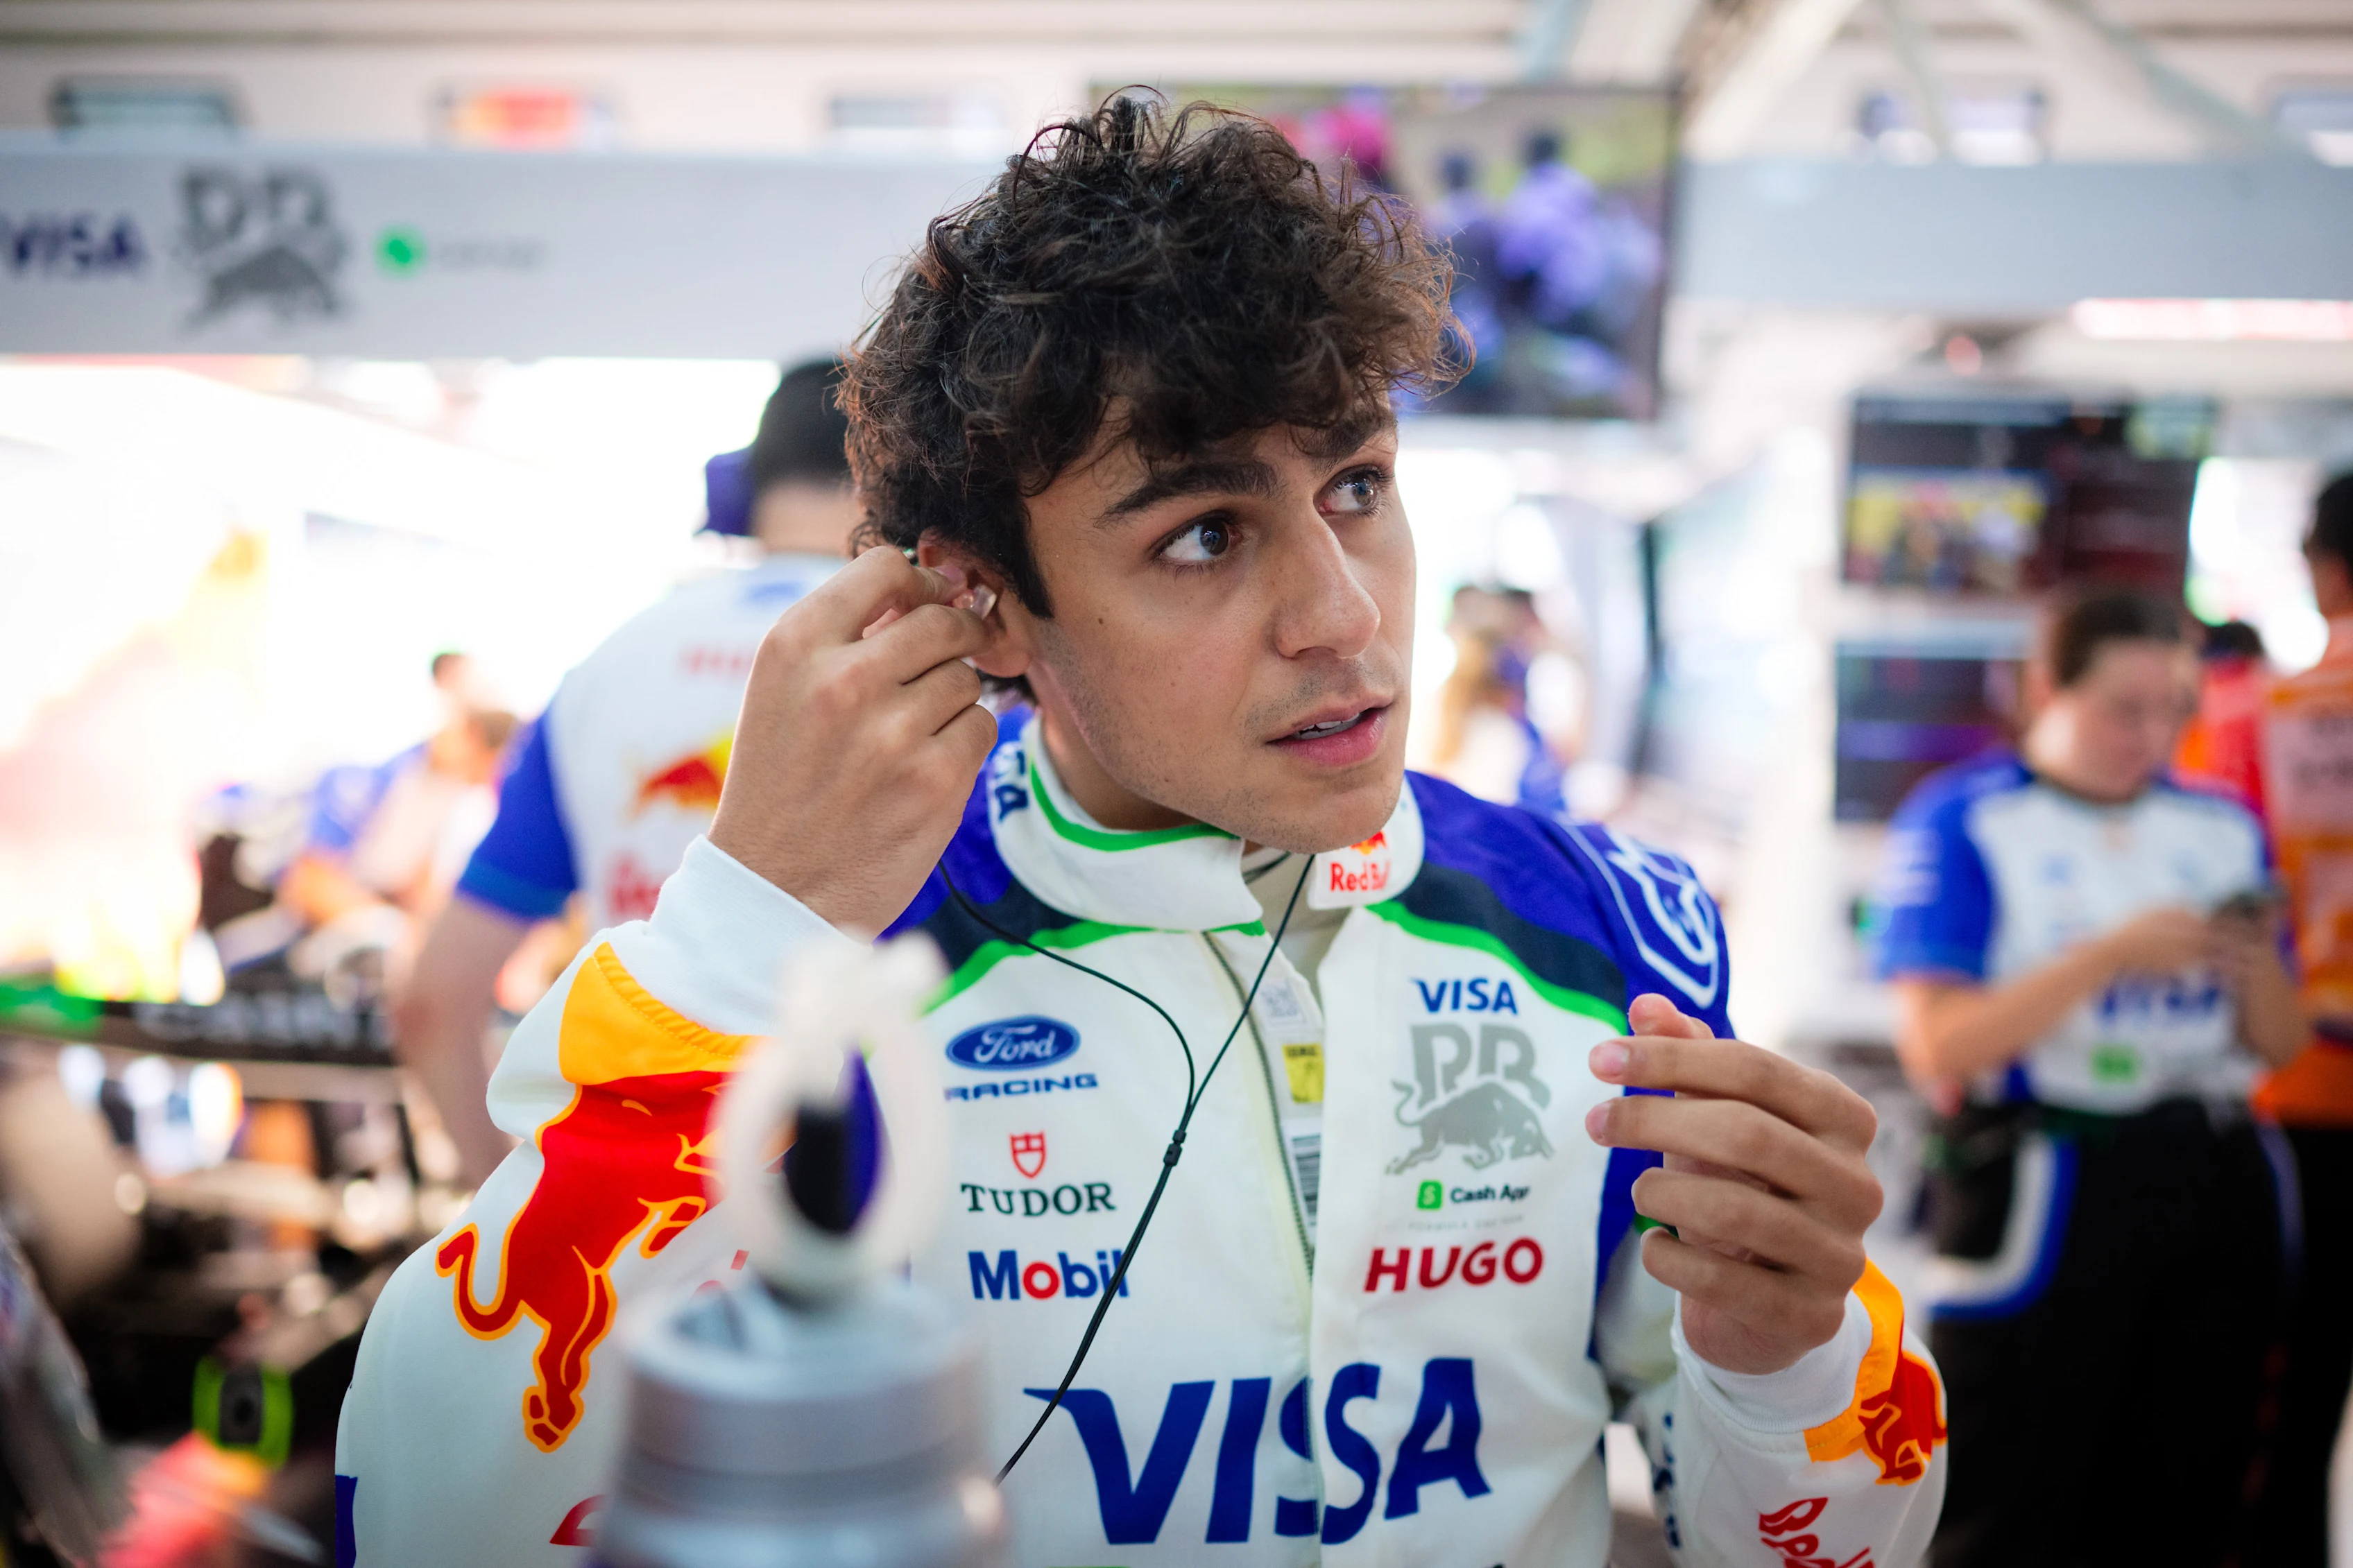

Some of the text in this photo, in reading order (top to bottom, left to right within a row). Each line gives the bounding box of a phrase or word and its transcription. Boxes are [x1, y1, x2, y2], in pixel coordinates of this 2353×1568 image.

[1330, 862, 1368, 892] Red
[1410, 977, 1518, 1015] VISA
[974, 1024, 1056, 1063] Ford
[944, 1073, 1098, 1102] RACING
[961, 1182, 1117, 1217] TUDOR
[1450, 1185, 1496, 1204] Cash
[968, 1249, 1129, 1300] Mobil
[1364, 1237, 1544, 1293] HUGO
[1023, 1357, 1492, 1545] VISA
